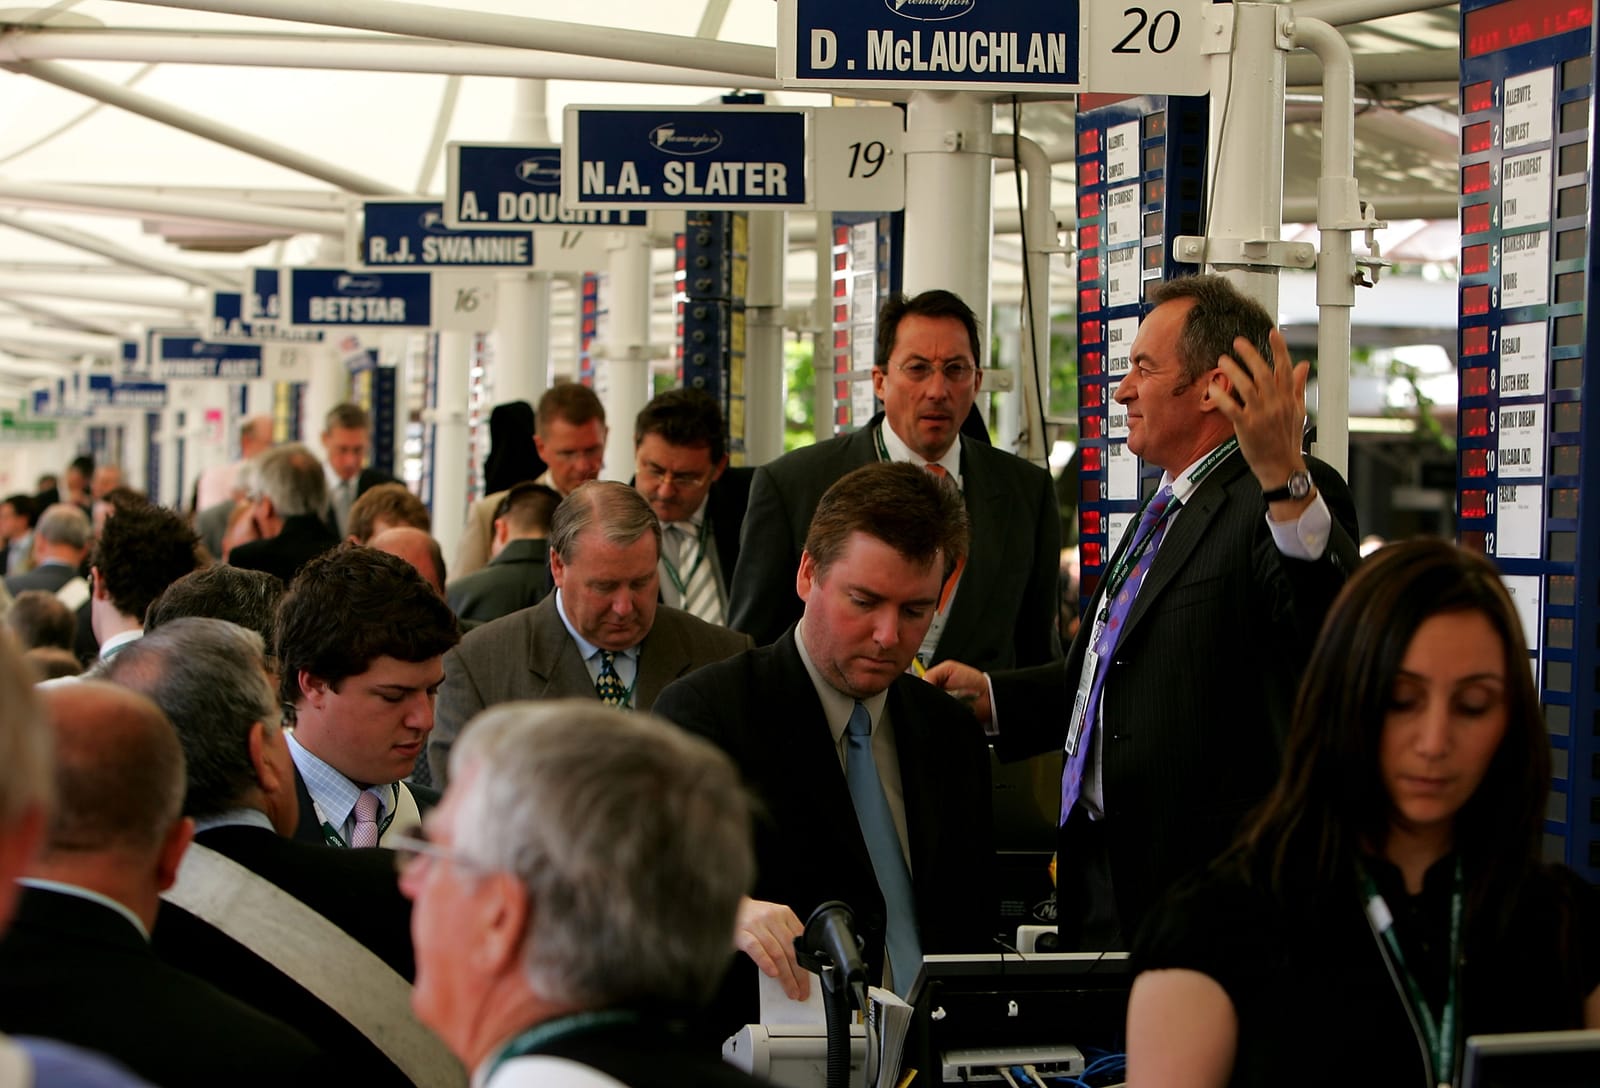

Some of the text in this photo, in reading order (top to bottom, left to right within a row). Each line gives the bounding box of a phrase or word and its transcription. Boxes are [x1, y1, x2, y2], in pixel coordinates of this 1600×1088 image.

[1110, 7, 1181, 54] 20
[867, 30, 1066, 73] McLAUCHLAN
[1505, 121, 1530, 144] SIMPLEST
[847, 141, 886, 179] 19
[1513, 156, 1542, 178] STANDFAST
[582, 161, 651, 195] N.A.
[664, 162, 788, 197] SLATER
[460, 191, 488, 221] A.
[369, 236, 529, 264] R.J. SWANNIE
[308, 296, 406, 323] BETSTAR
[454, 288, 481, 313] 16
[1500, 372, 1530, 393] LISTEN HERE
[1501, 409, 1536, 429] SWIRLY DREAM
